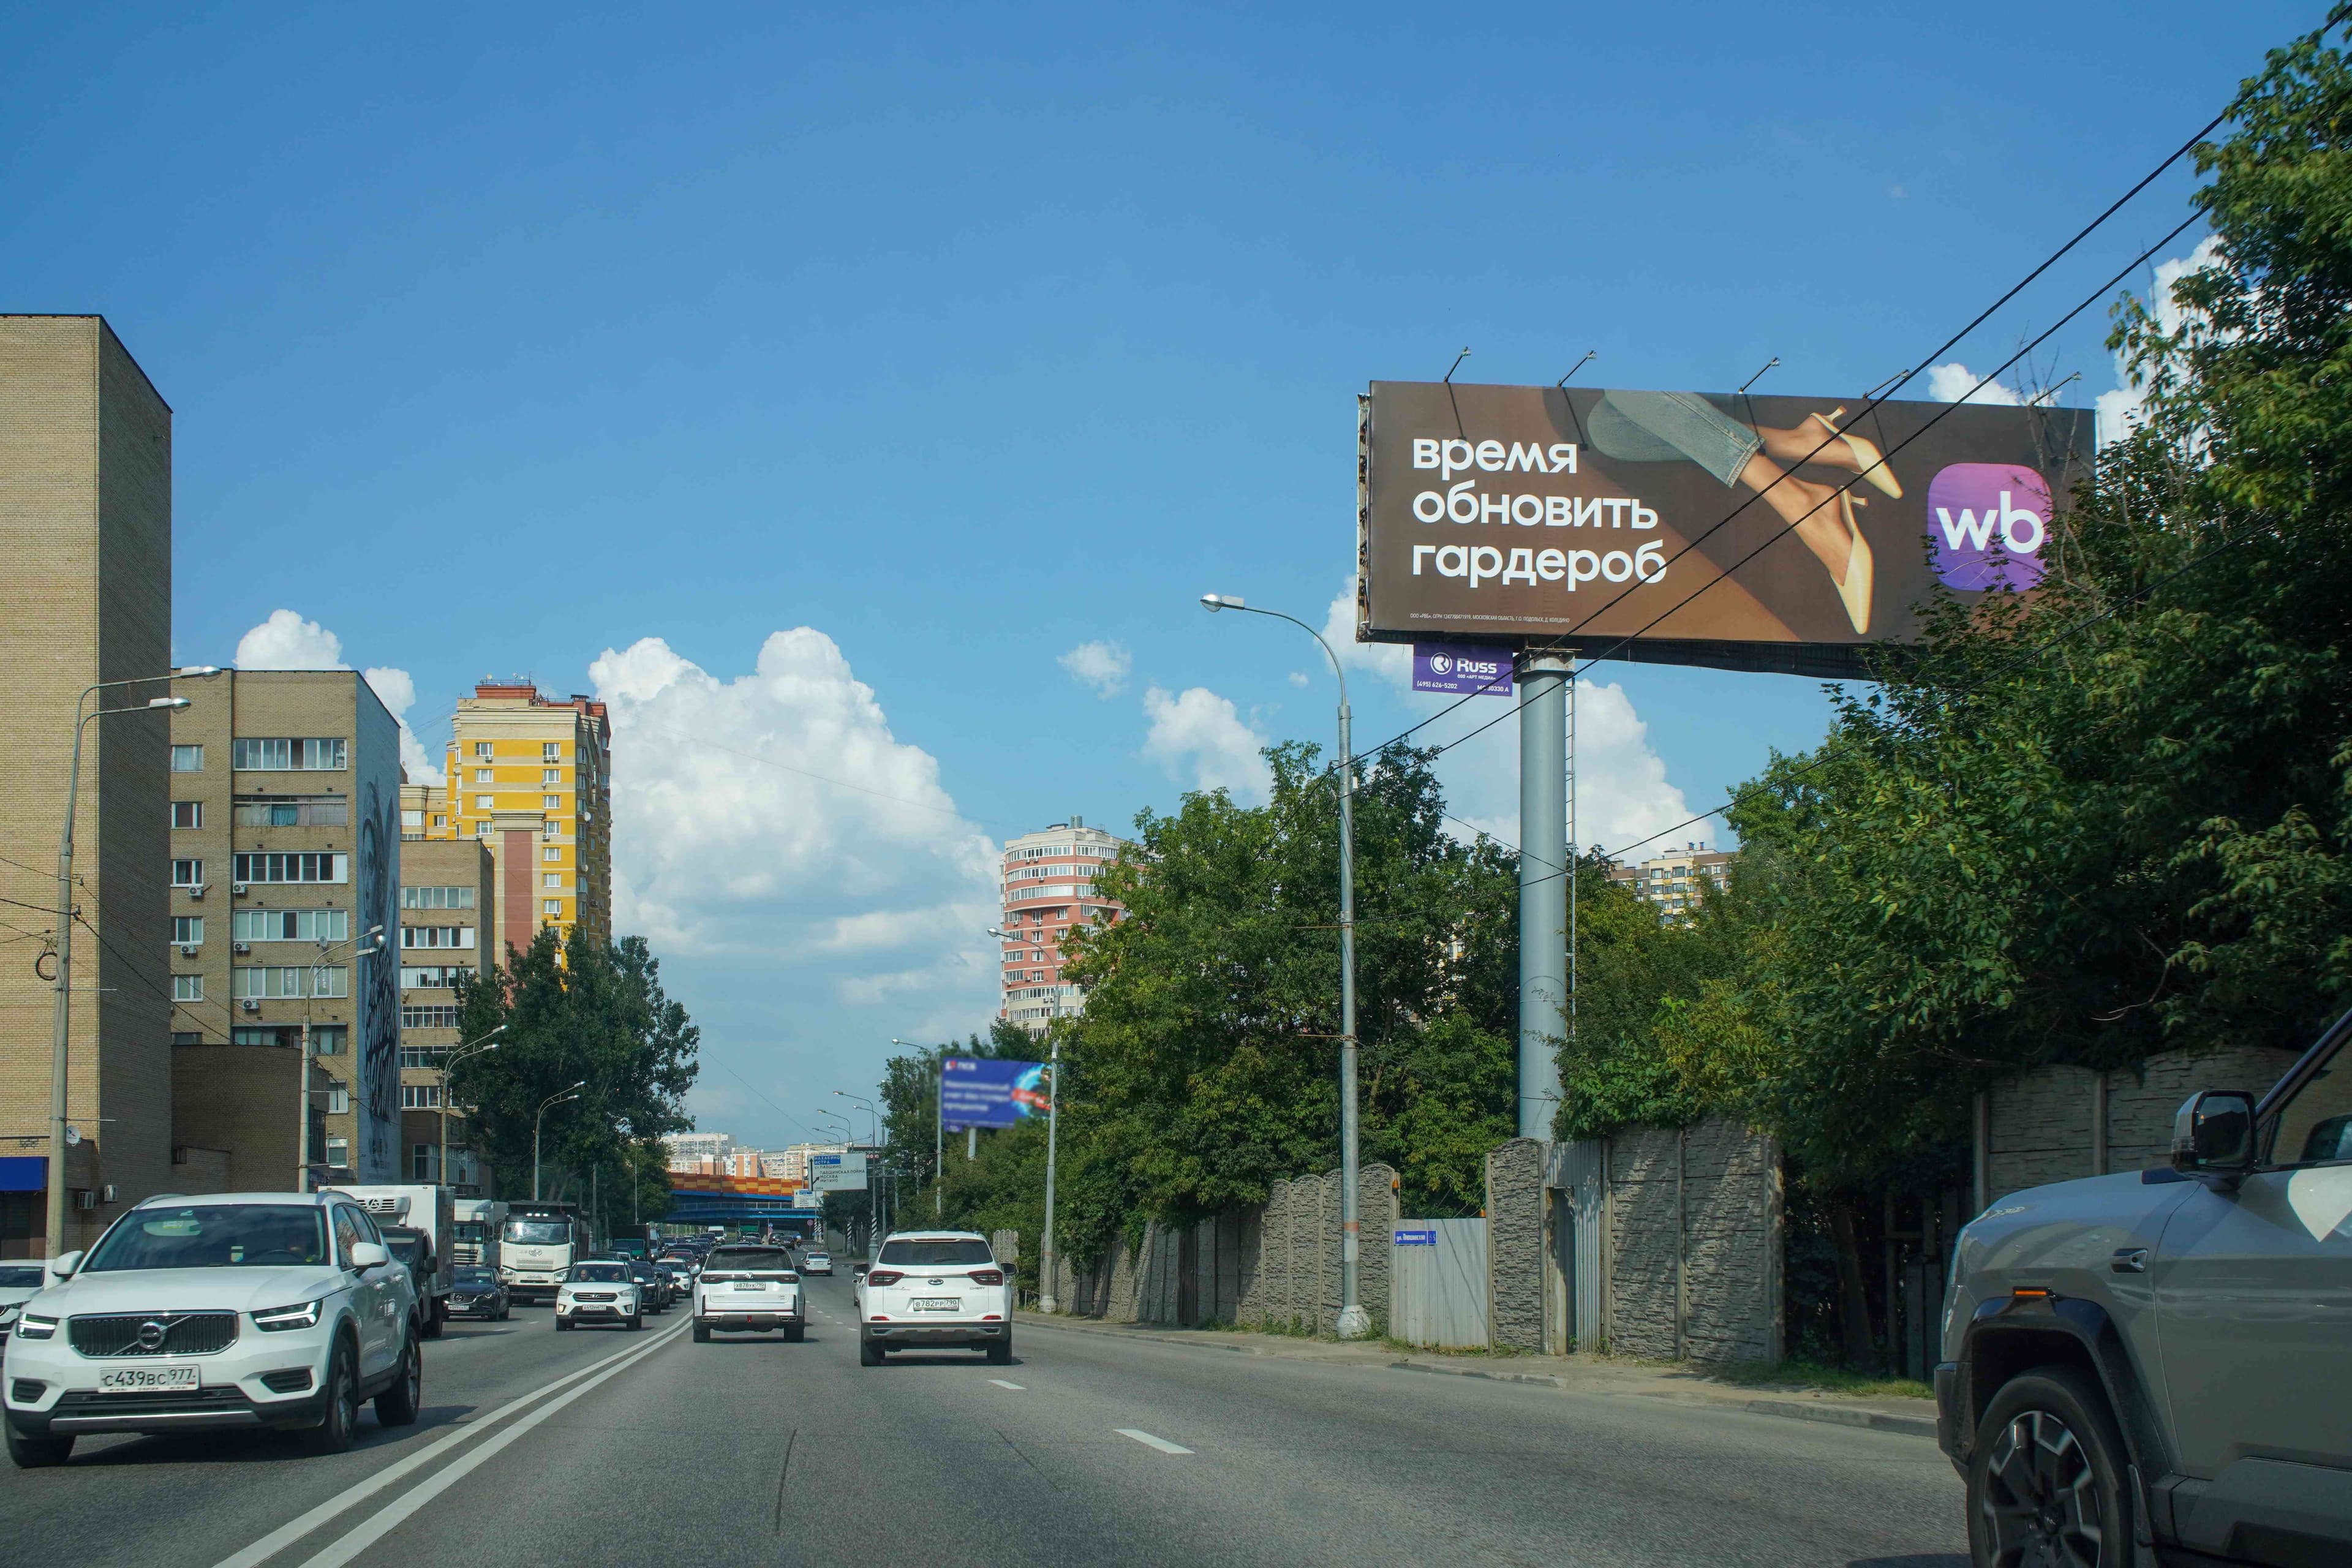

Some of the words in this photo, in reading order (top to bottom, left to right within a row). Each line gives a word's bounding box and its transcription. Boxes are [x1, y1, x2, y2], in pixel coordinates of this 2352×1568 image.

[1413, 439, 1577, 481] время
[1412, 480, 1659, 529] обновить
[1936, 491, 2045, 554] wb
[1412, 540, 1667, 592] гардероб
[104, 1371, 167, 1387] С439ВС
[169, 1368, 194, 1381] 977
